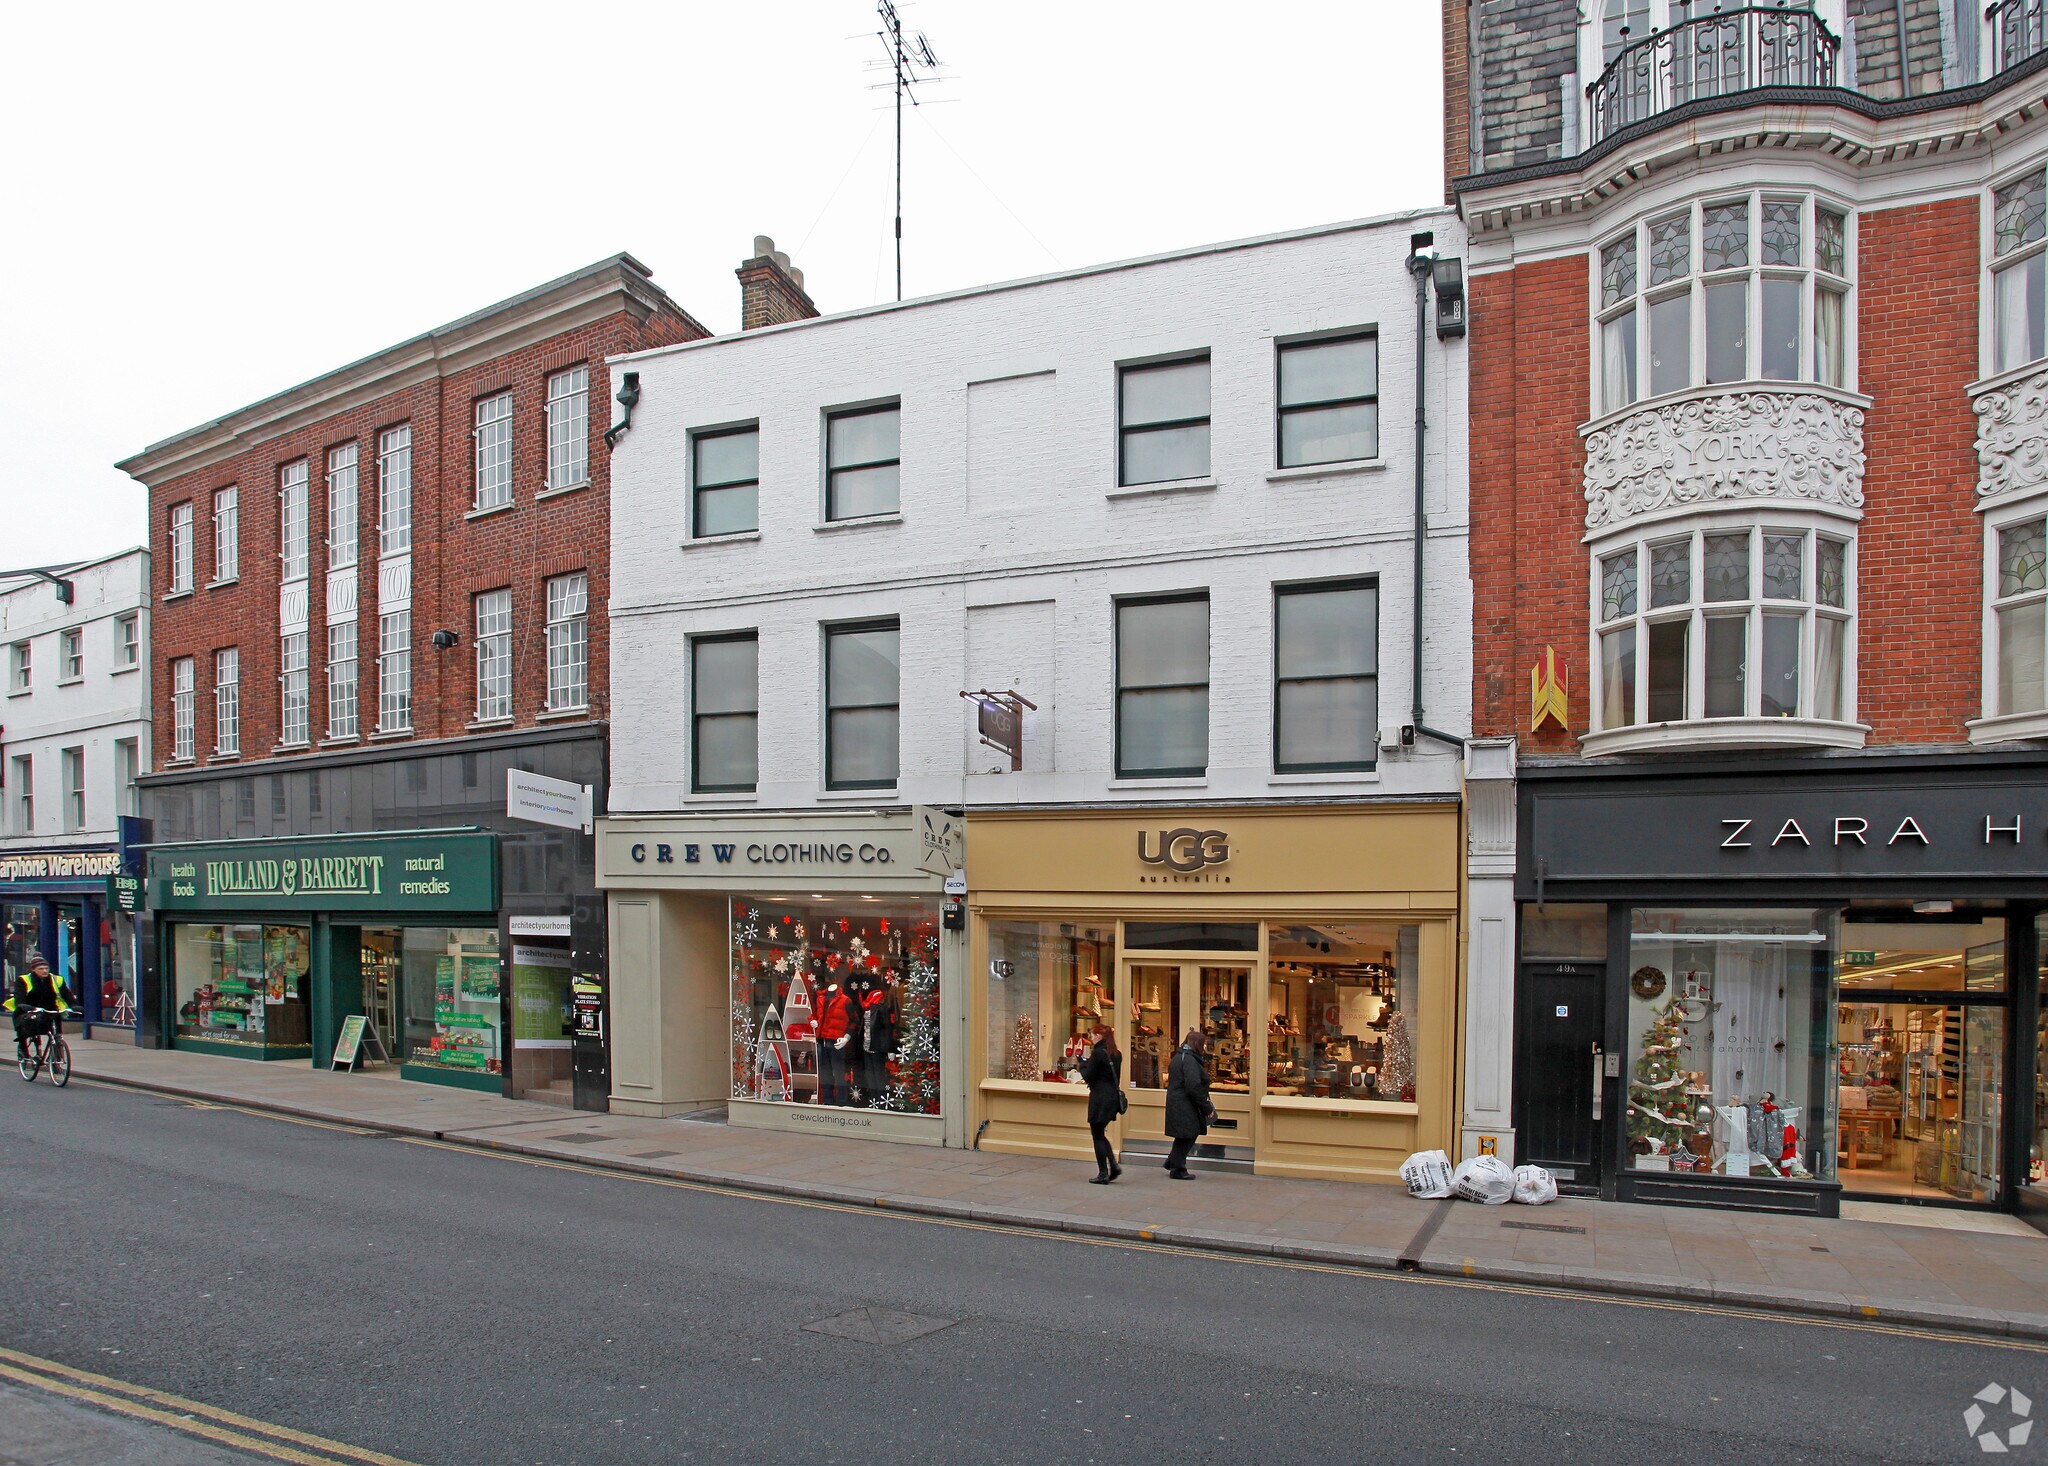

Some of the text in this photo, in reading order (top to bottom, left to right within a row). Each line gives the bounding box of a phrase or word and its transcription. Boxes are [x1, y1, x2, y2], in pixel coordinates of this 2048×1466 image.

[1677, 432, 1775, 467] YORK
[517, 784, 577, 802] architectyourhome
[519, 799, 574, 816] interioryourhome
[924, 831, 951, 847] CREW
[1720, 814, 2023, 847] ZARA H
[631, 843, 896, 864] CREW CLOTHING Co.
[1137, 827, 1229, 872] UGG
[48, 853, 121, 876] Warehouse
[171, 863, 196, 877] health
[405, 853, 445, 871] natural
[206, 855, 384, 896] HOLLAND & BARRETT
[1140, 874, 1231, 883] australia
[172, 882, 196, 896] foods
[400, 877, 451, 895] remedies
[511, 921, 571, 930] architectyourhome
[1556, 964, 1576, 973] 49A
[791, 1112, 872, 1127] crewclothing.co.uk
